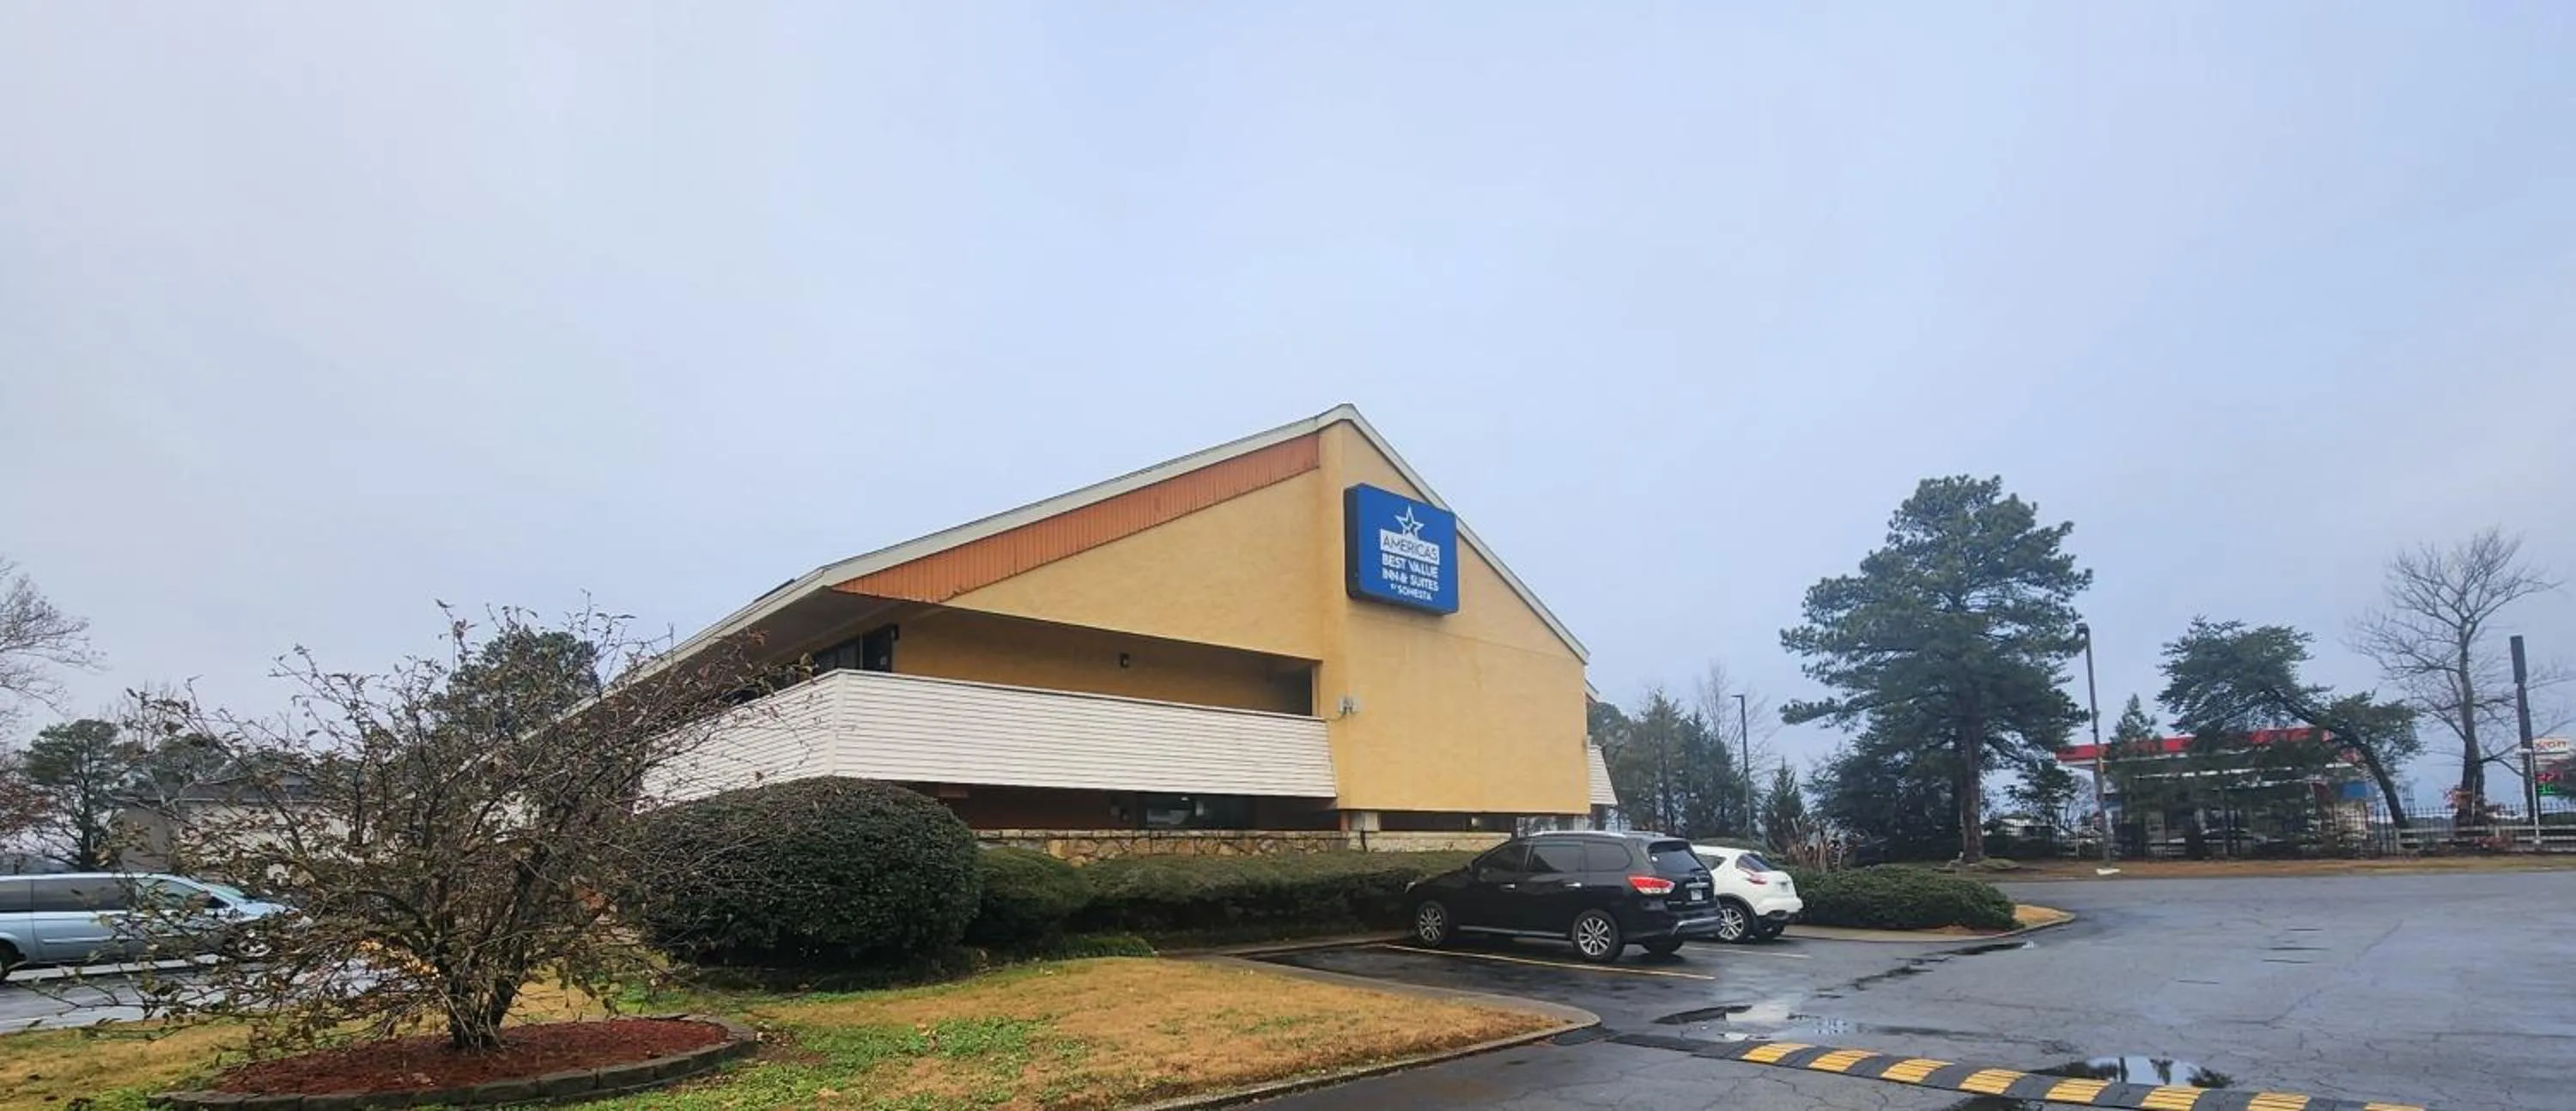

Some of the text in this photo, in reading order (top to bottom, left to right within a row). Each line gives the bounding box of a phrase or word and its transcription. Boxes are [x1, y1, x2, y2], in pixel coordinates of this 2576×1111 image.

[1383, 535, 1437, 561] AMERICAS
[1382, 552, 1438, 580] BEST VALUE
[1382, 567, 1399, 582] INN
[1409, 574, 1439, 592] SUITES
